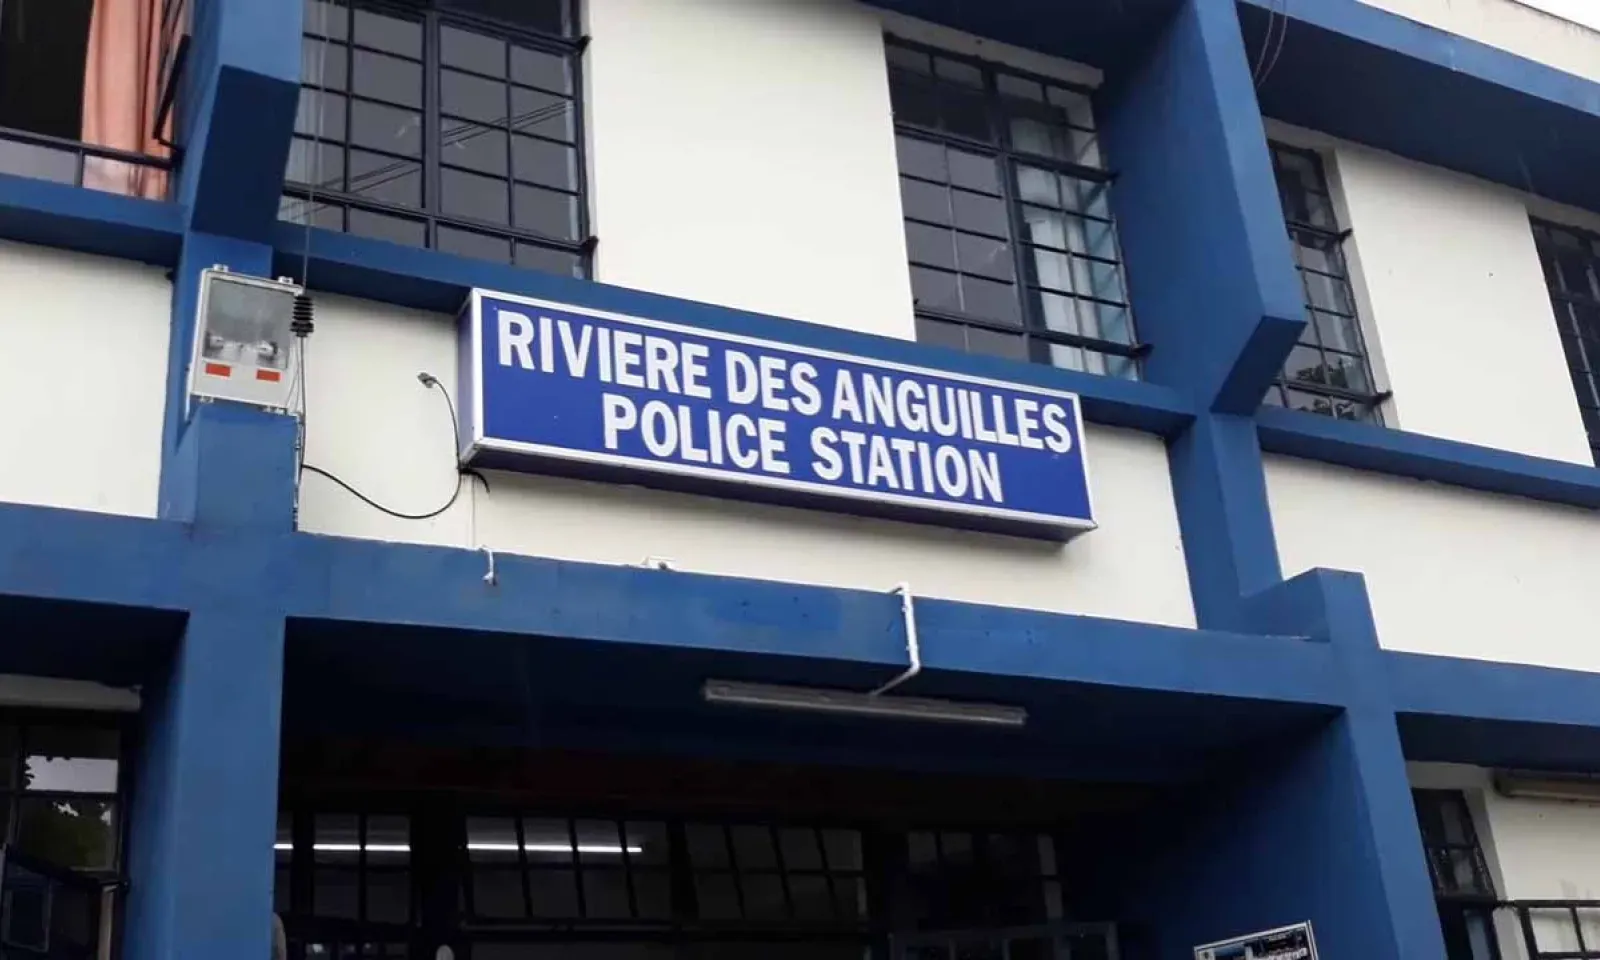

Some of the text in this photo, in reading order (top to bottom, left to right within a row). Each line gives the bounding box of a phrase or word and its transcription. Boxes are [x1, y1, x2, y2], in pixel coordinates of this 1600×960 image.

[497, 310, 1073, 454] RIVIERE DES ANGUILLES
[603, 393, 1003, 503] POLICE STATION
